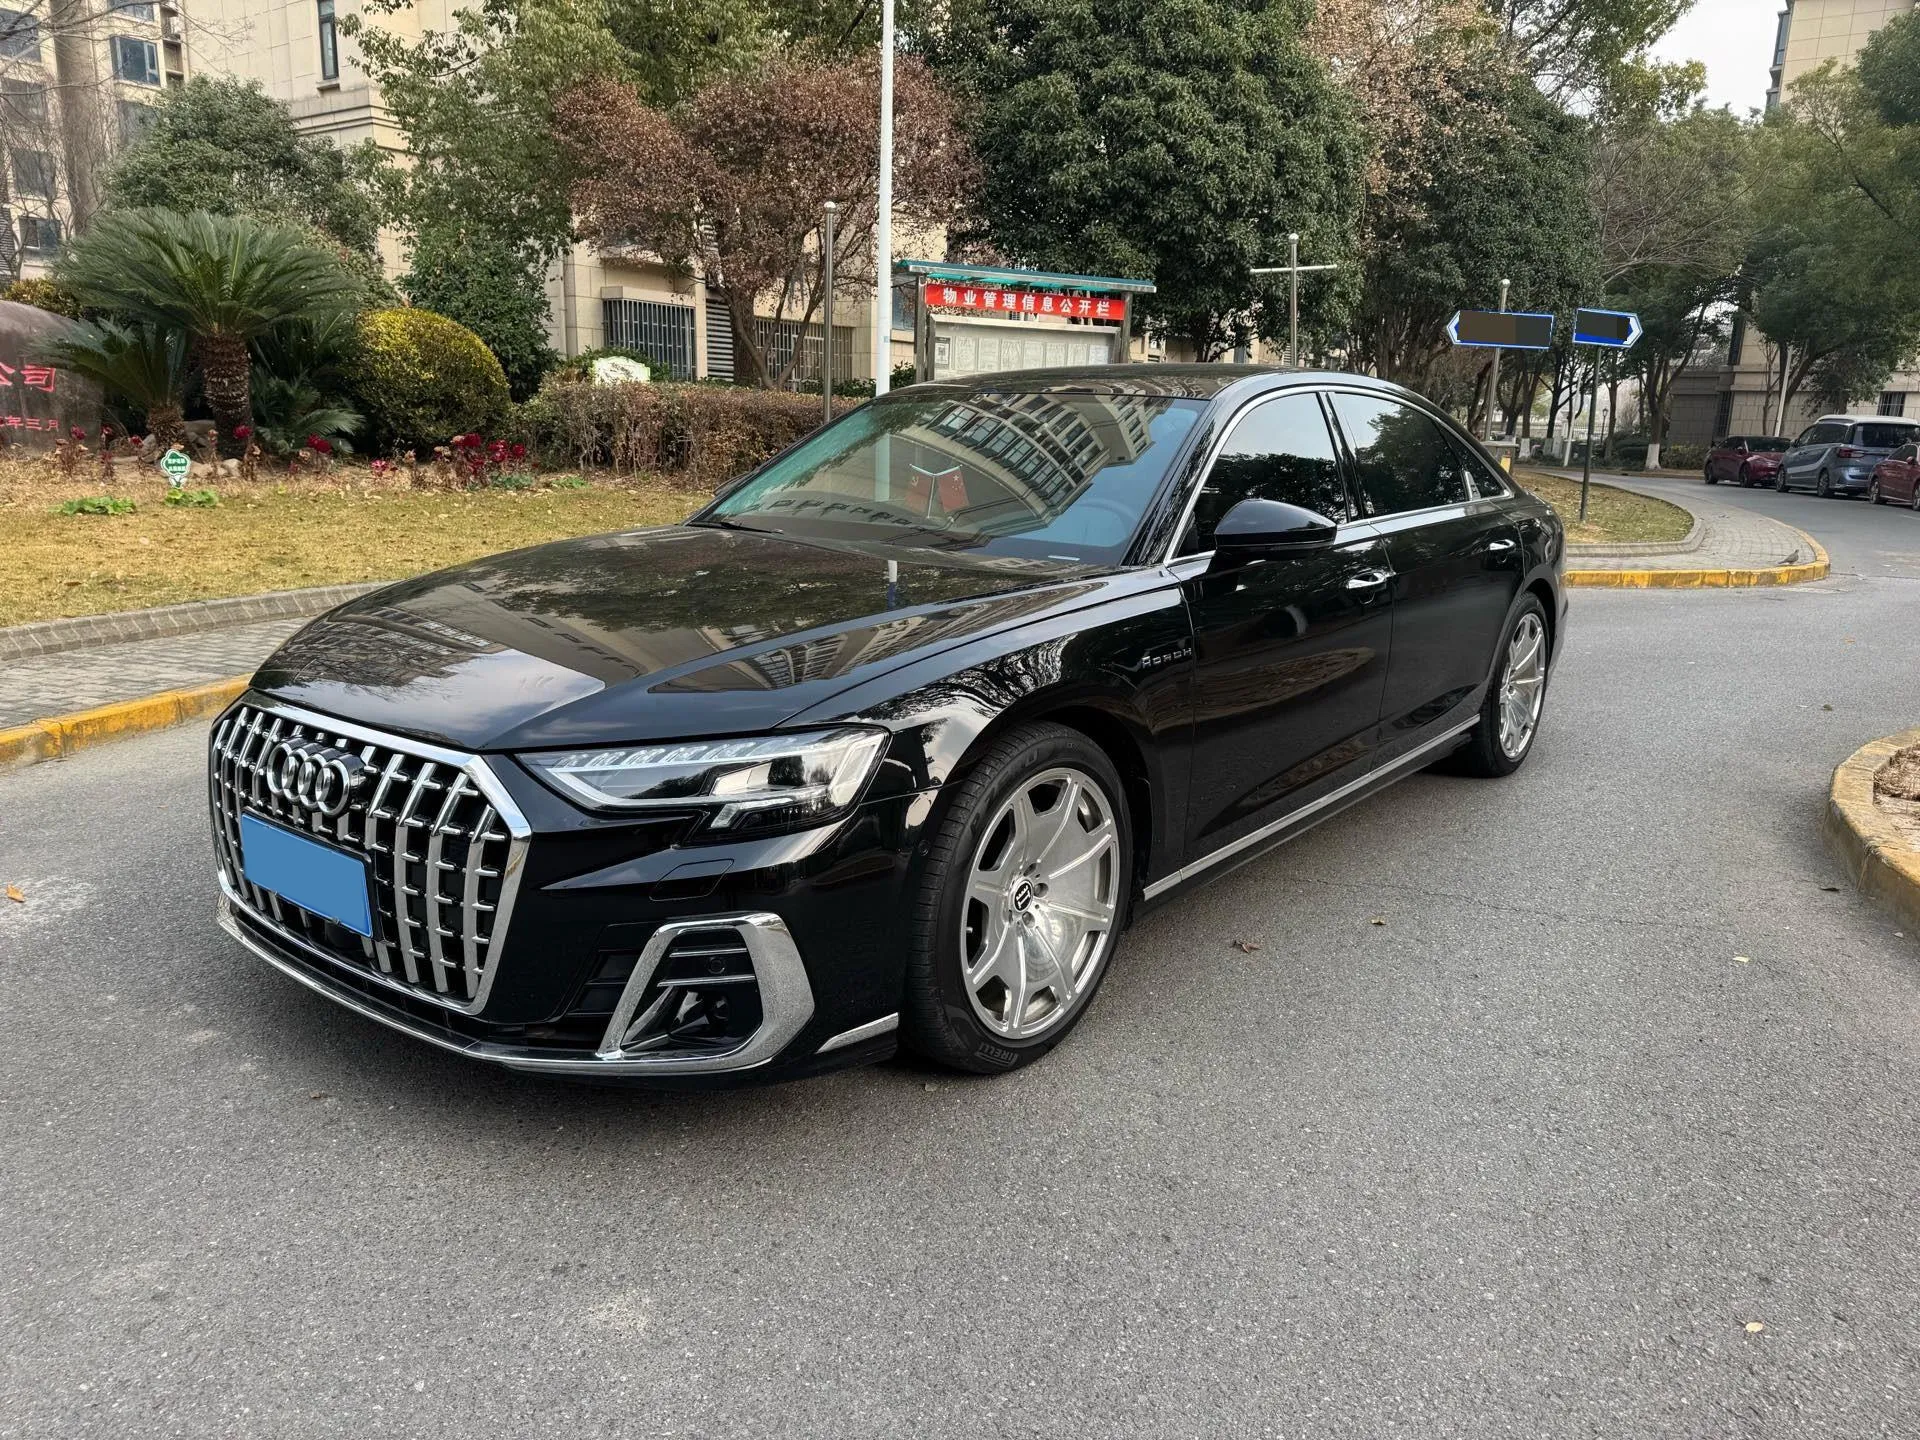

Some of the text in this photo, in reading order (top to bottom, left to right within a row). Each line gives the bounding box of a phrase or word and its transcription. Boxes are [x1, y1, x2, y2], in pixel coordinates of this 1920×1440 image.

[943, 287, 1110, 317] 物业管理信息公开栏
